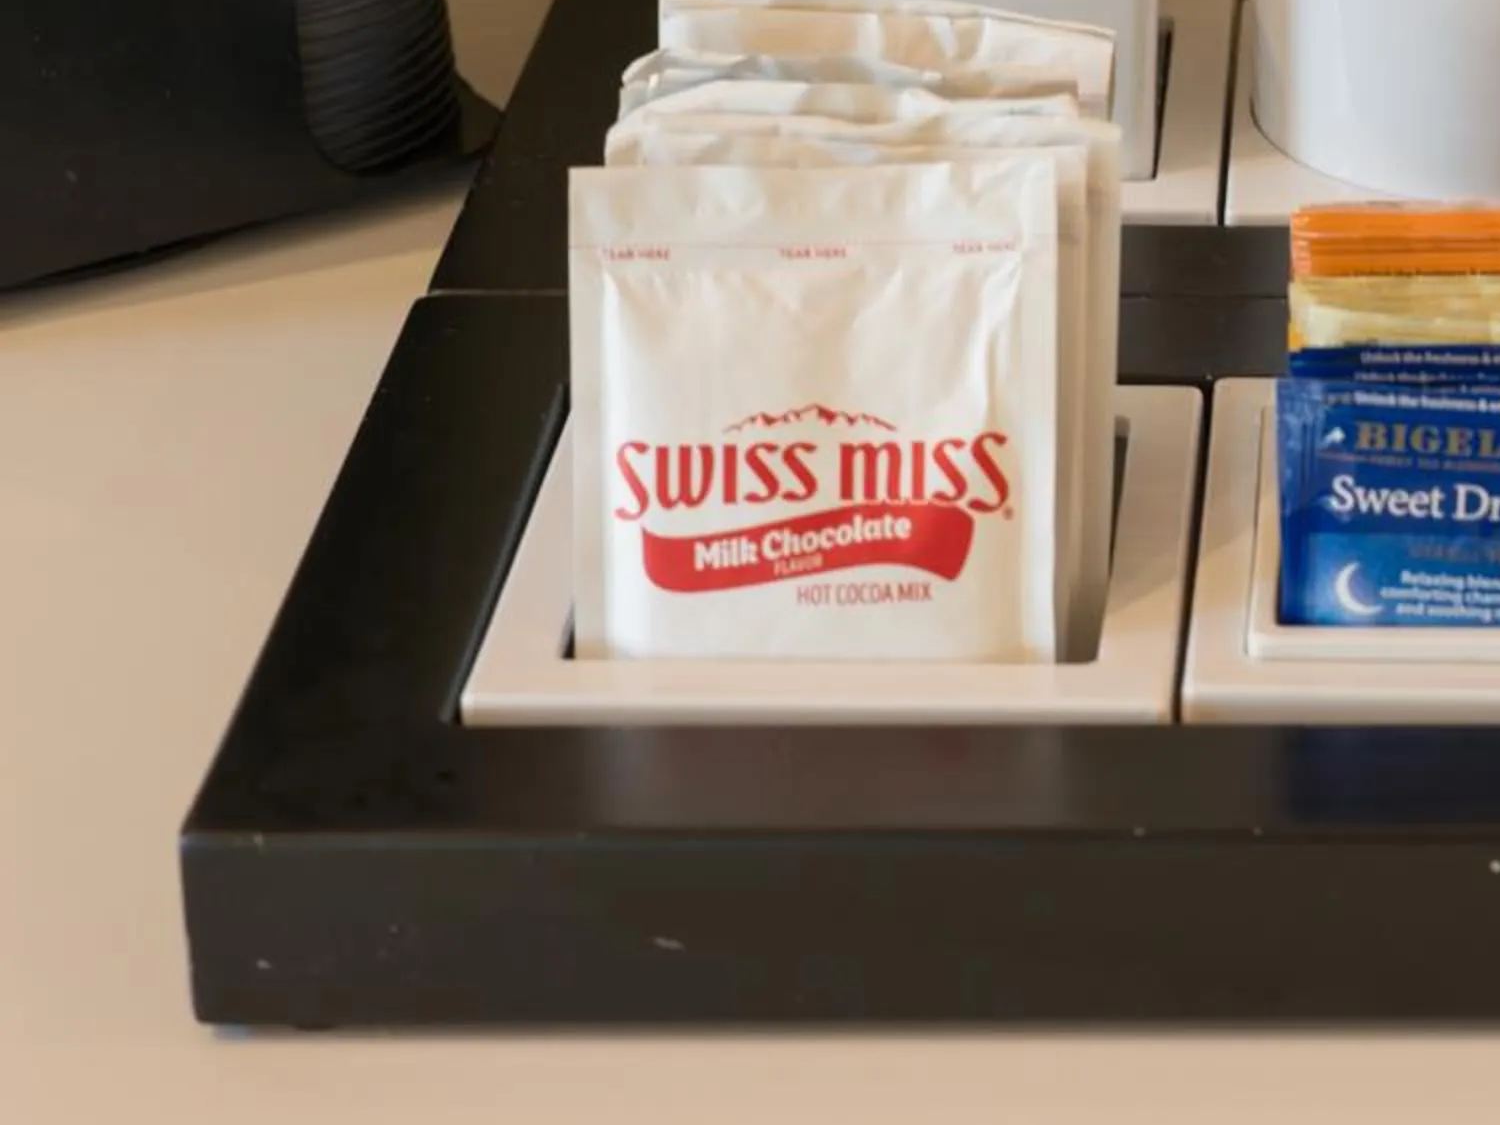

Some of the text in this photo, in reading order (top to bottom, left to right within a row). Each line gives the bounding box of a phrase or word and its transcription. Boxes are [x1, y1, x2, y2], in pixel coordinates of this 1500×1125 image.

[614, 441, 818, 521] SWISS
[1330, 474, 1446, 518] Sweet
[693, 514, 912, 571] Milk Chocolate
[774, 555, 823, 576] FLAVOR
[797, 583, 932, 606] HOT COCOA MIX
